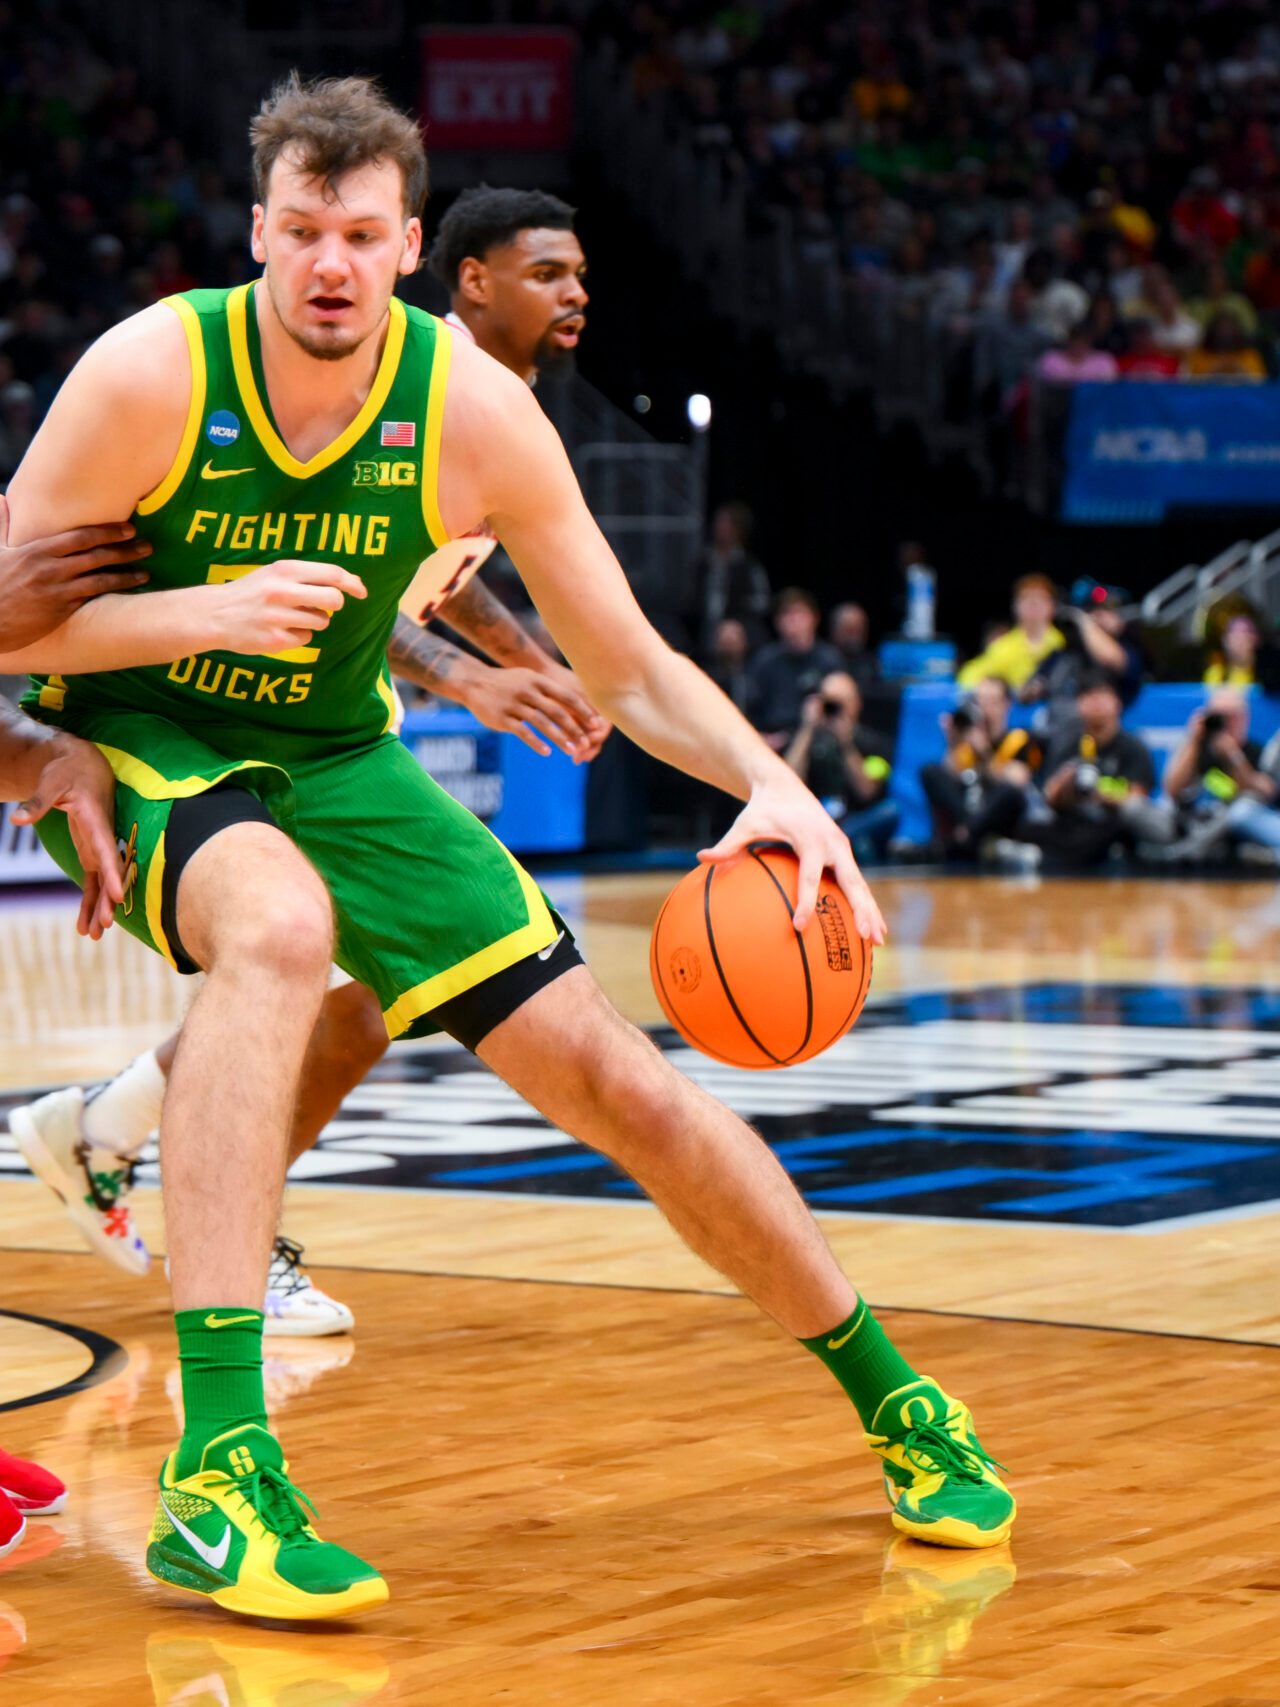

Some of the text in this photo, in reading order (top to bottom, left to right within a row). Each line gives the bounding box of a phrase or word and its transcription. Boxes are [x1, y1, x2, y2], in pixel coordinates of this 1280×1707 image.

[210, 425, 239, 439] NCAA
[185, 509, 390, 555] FIGHTING
[167, 652, 313, 704] DUCKS
